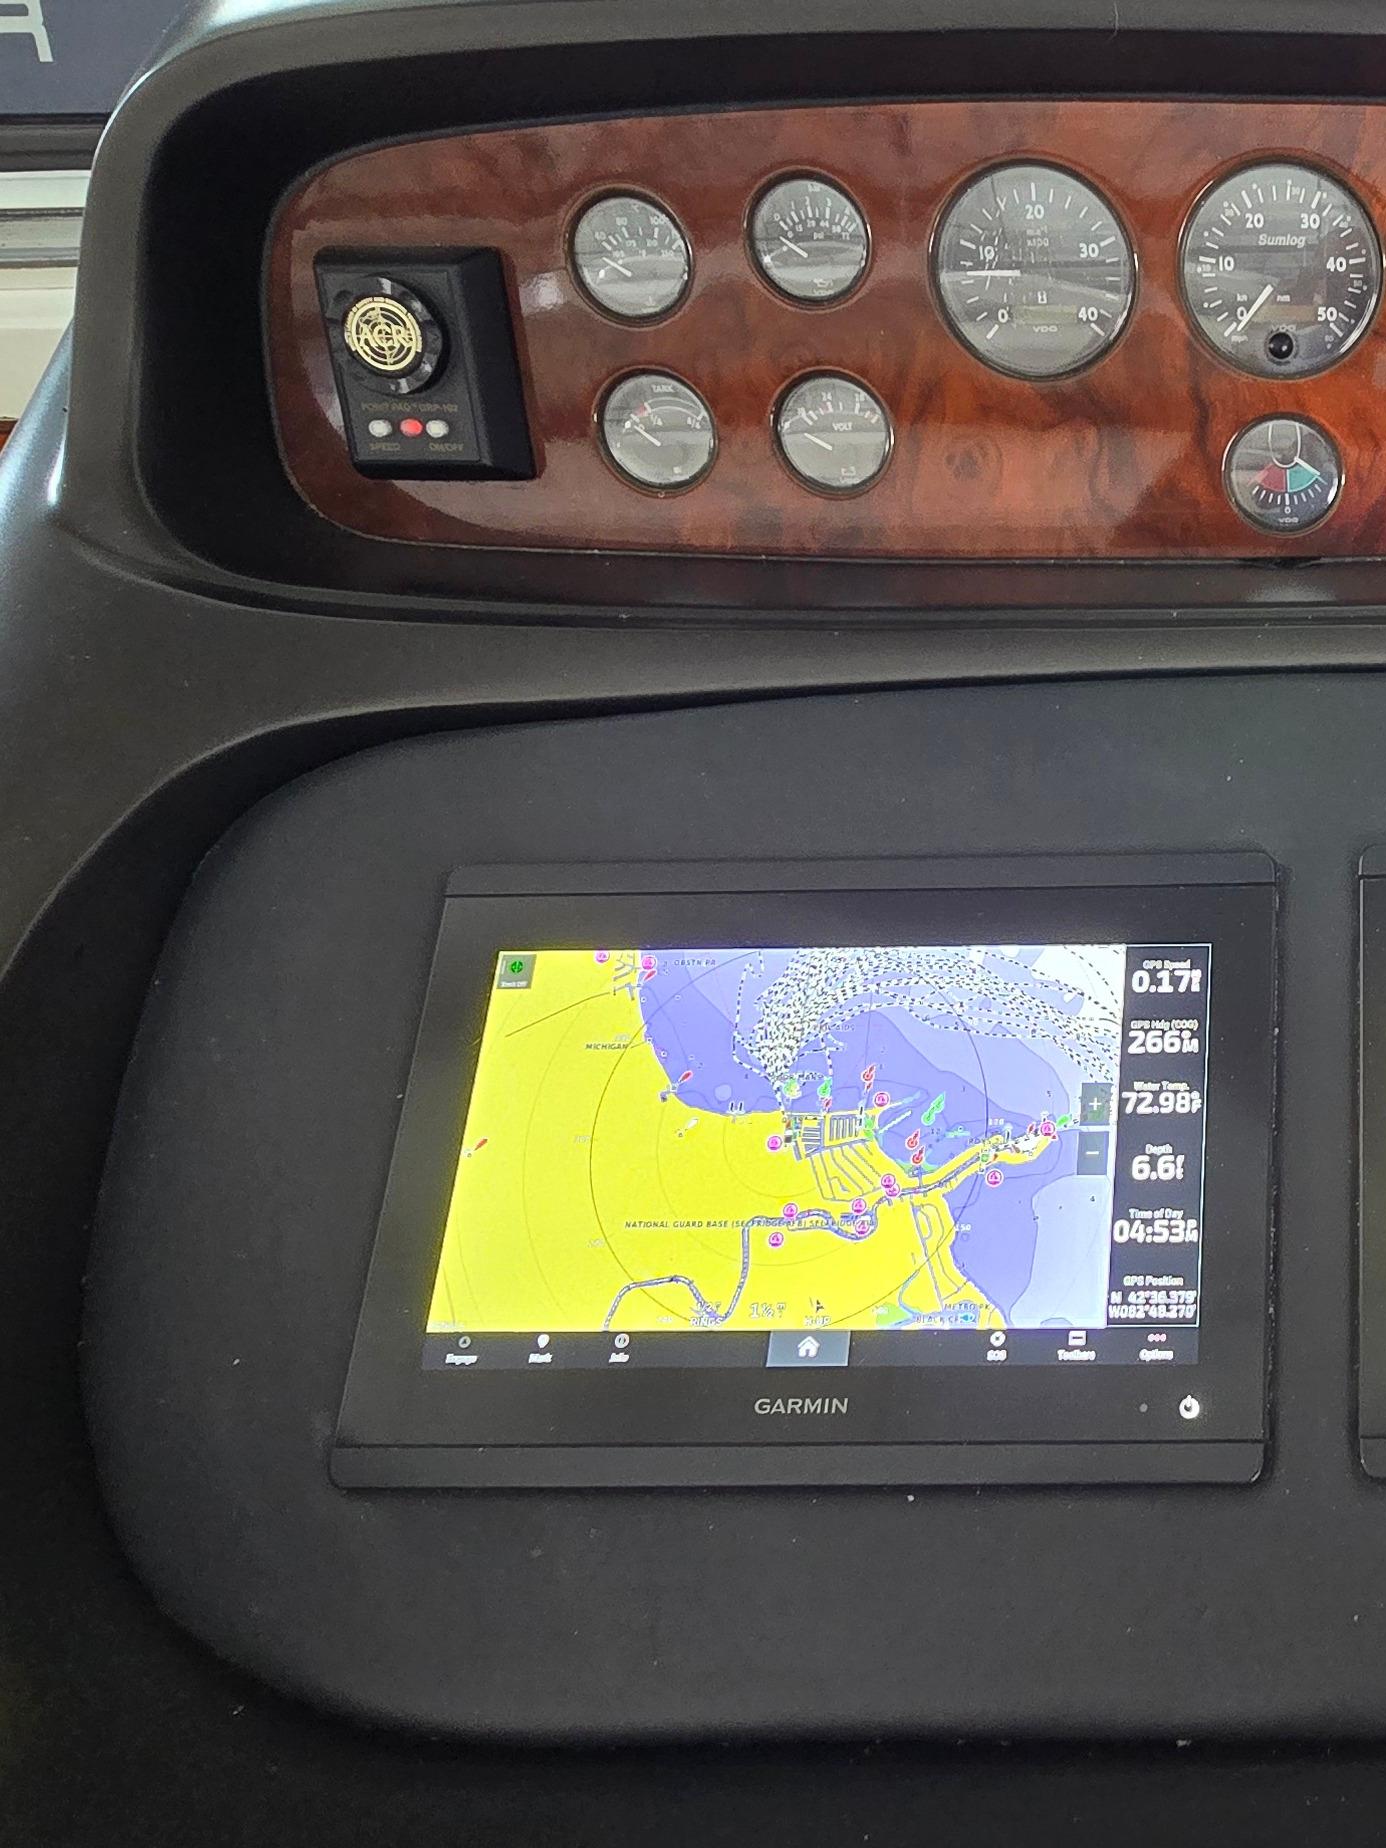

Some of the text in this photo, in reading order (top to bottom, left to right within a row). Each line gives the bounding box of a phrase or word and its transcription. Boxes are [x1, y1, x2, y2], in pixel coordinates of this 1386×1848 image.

[1025, 204, 1045, 220] 20
[1245, 213, 1265, 229] 20
[1300, 213, 1321, 229] 30
[1258, 233, 1306, 249] Sumlog
[979, 245, 995, 260] 10
[1079, 243, 1099, 258] 30
[1218, 256, 1235, 271] 10
[1326, 256, 1347, 272] 40
[998, 309, 1008, 323] 0
[1078, 306, 1099, 322] 40
[1236, 306, 1247, 320] 0
[1317, 307, 1338, 323] 50
[359, 322, 414, 351] ACR
[690, 1317, 723, 1326] RINGS
[754, 1398, 849, 1415] GARMIN
